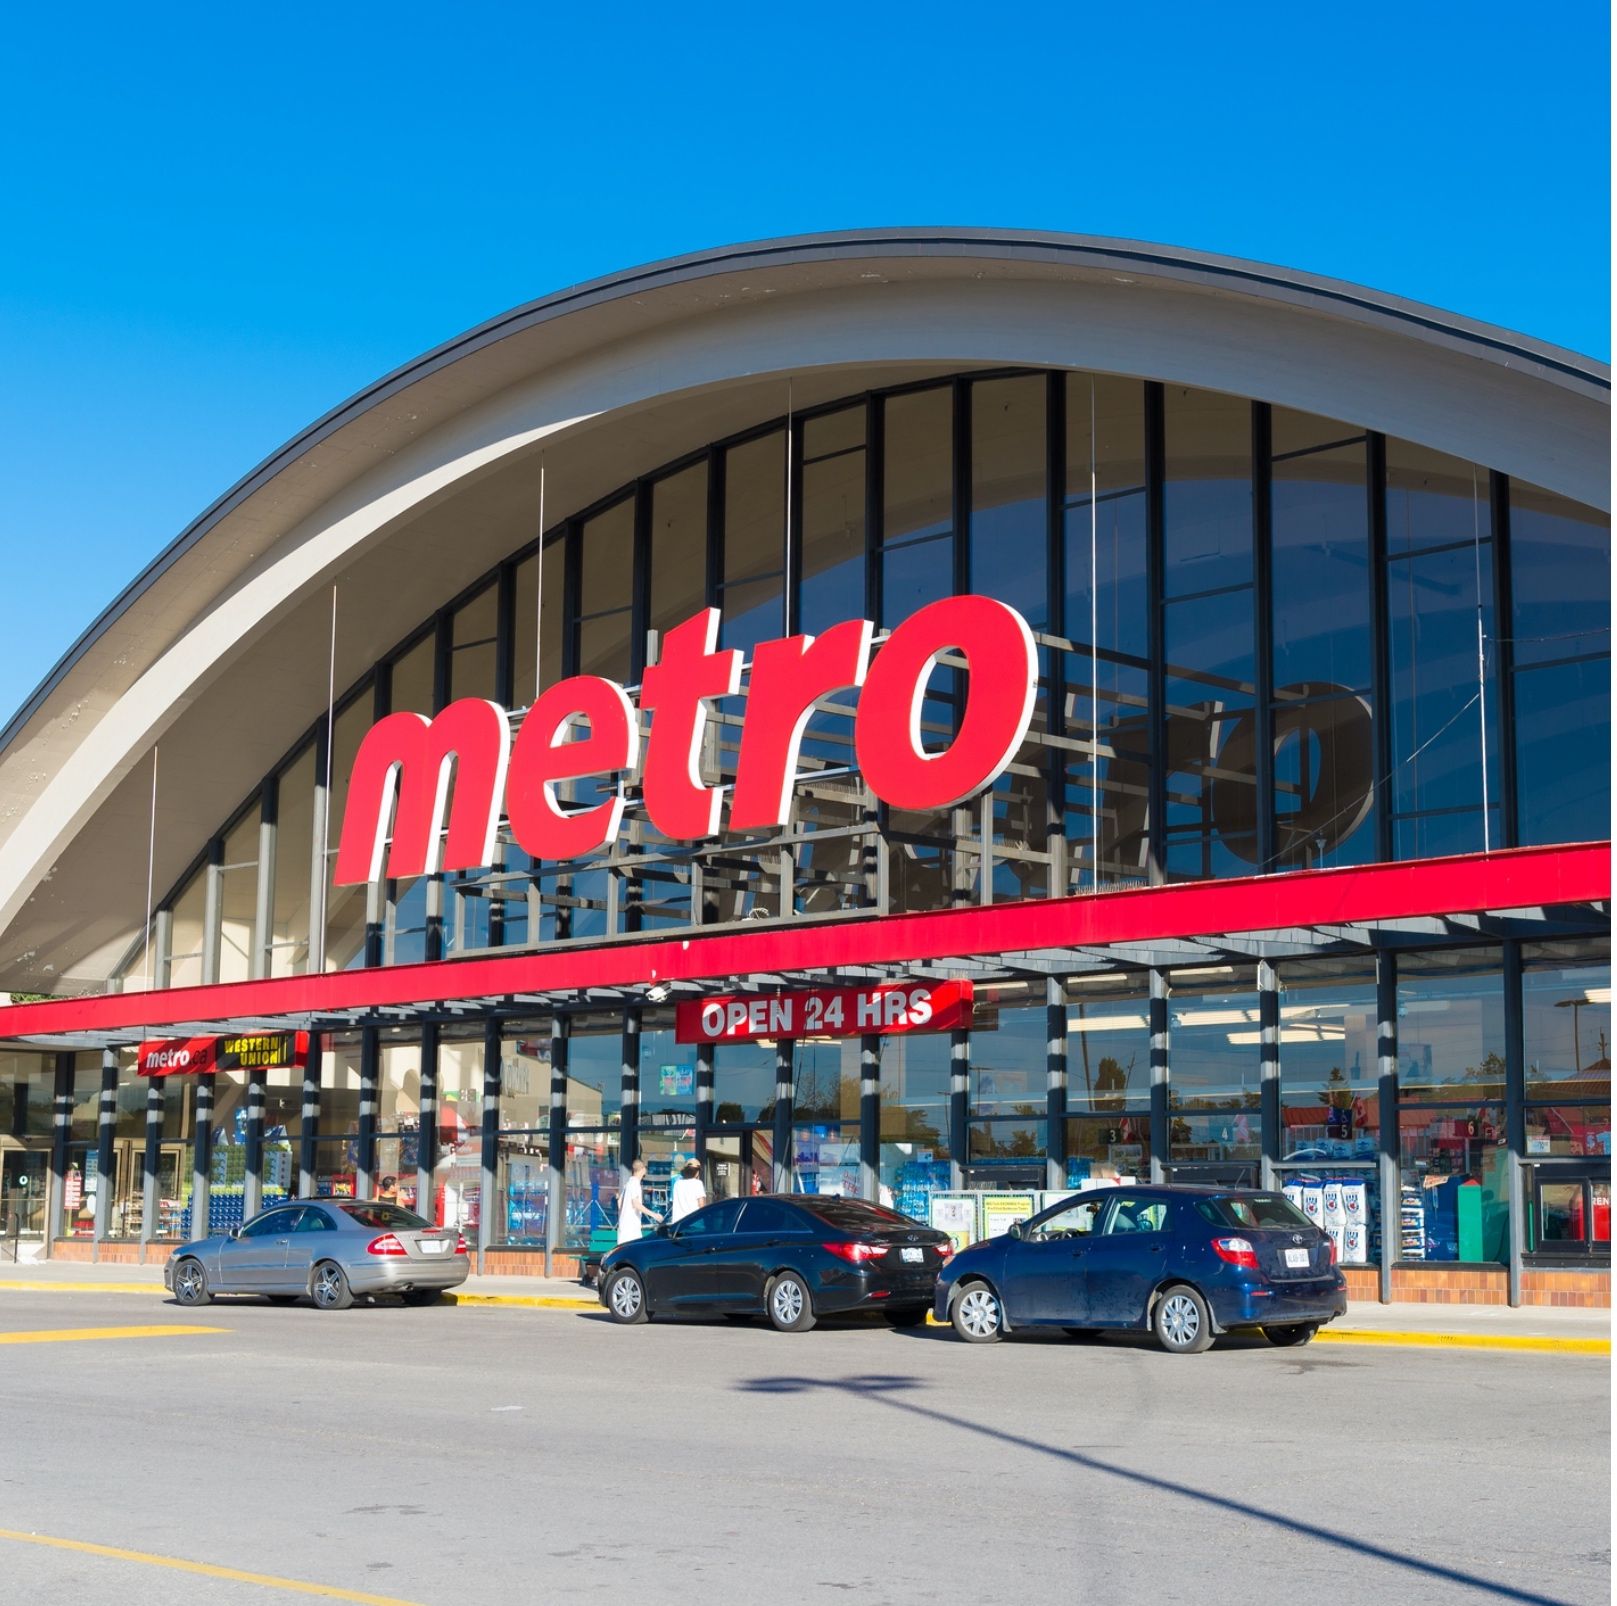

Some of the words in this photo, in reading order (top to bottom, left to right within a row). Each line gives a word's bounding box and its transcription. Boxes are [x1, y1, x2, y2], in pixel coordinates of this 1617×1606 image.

[334, 594, 1038, 886] metro
[702, 998, 792, 1037] OPEN
[804, 996, 845, 1030] 24
[857, 988, 933, 1027] HRS
[224, 1036, 279, 1053] WESTERN
[240, 1049, 280, 1066] UNION
[1109, 1129, 1117, 1142] 3
[1221, 1127, 1229, 1141] 4
[1340, 1124, 1349, 1139] 5
[1467, 1120, 1475, 1136] 6
